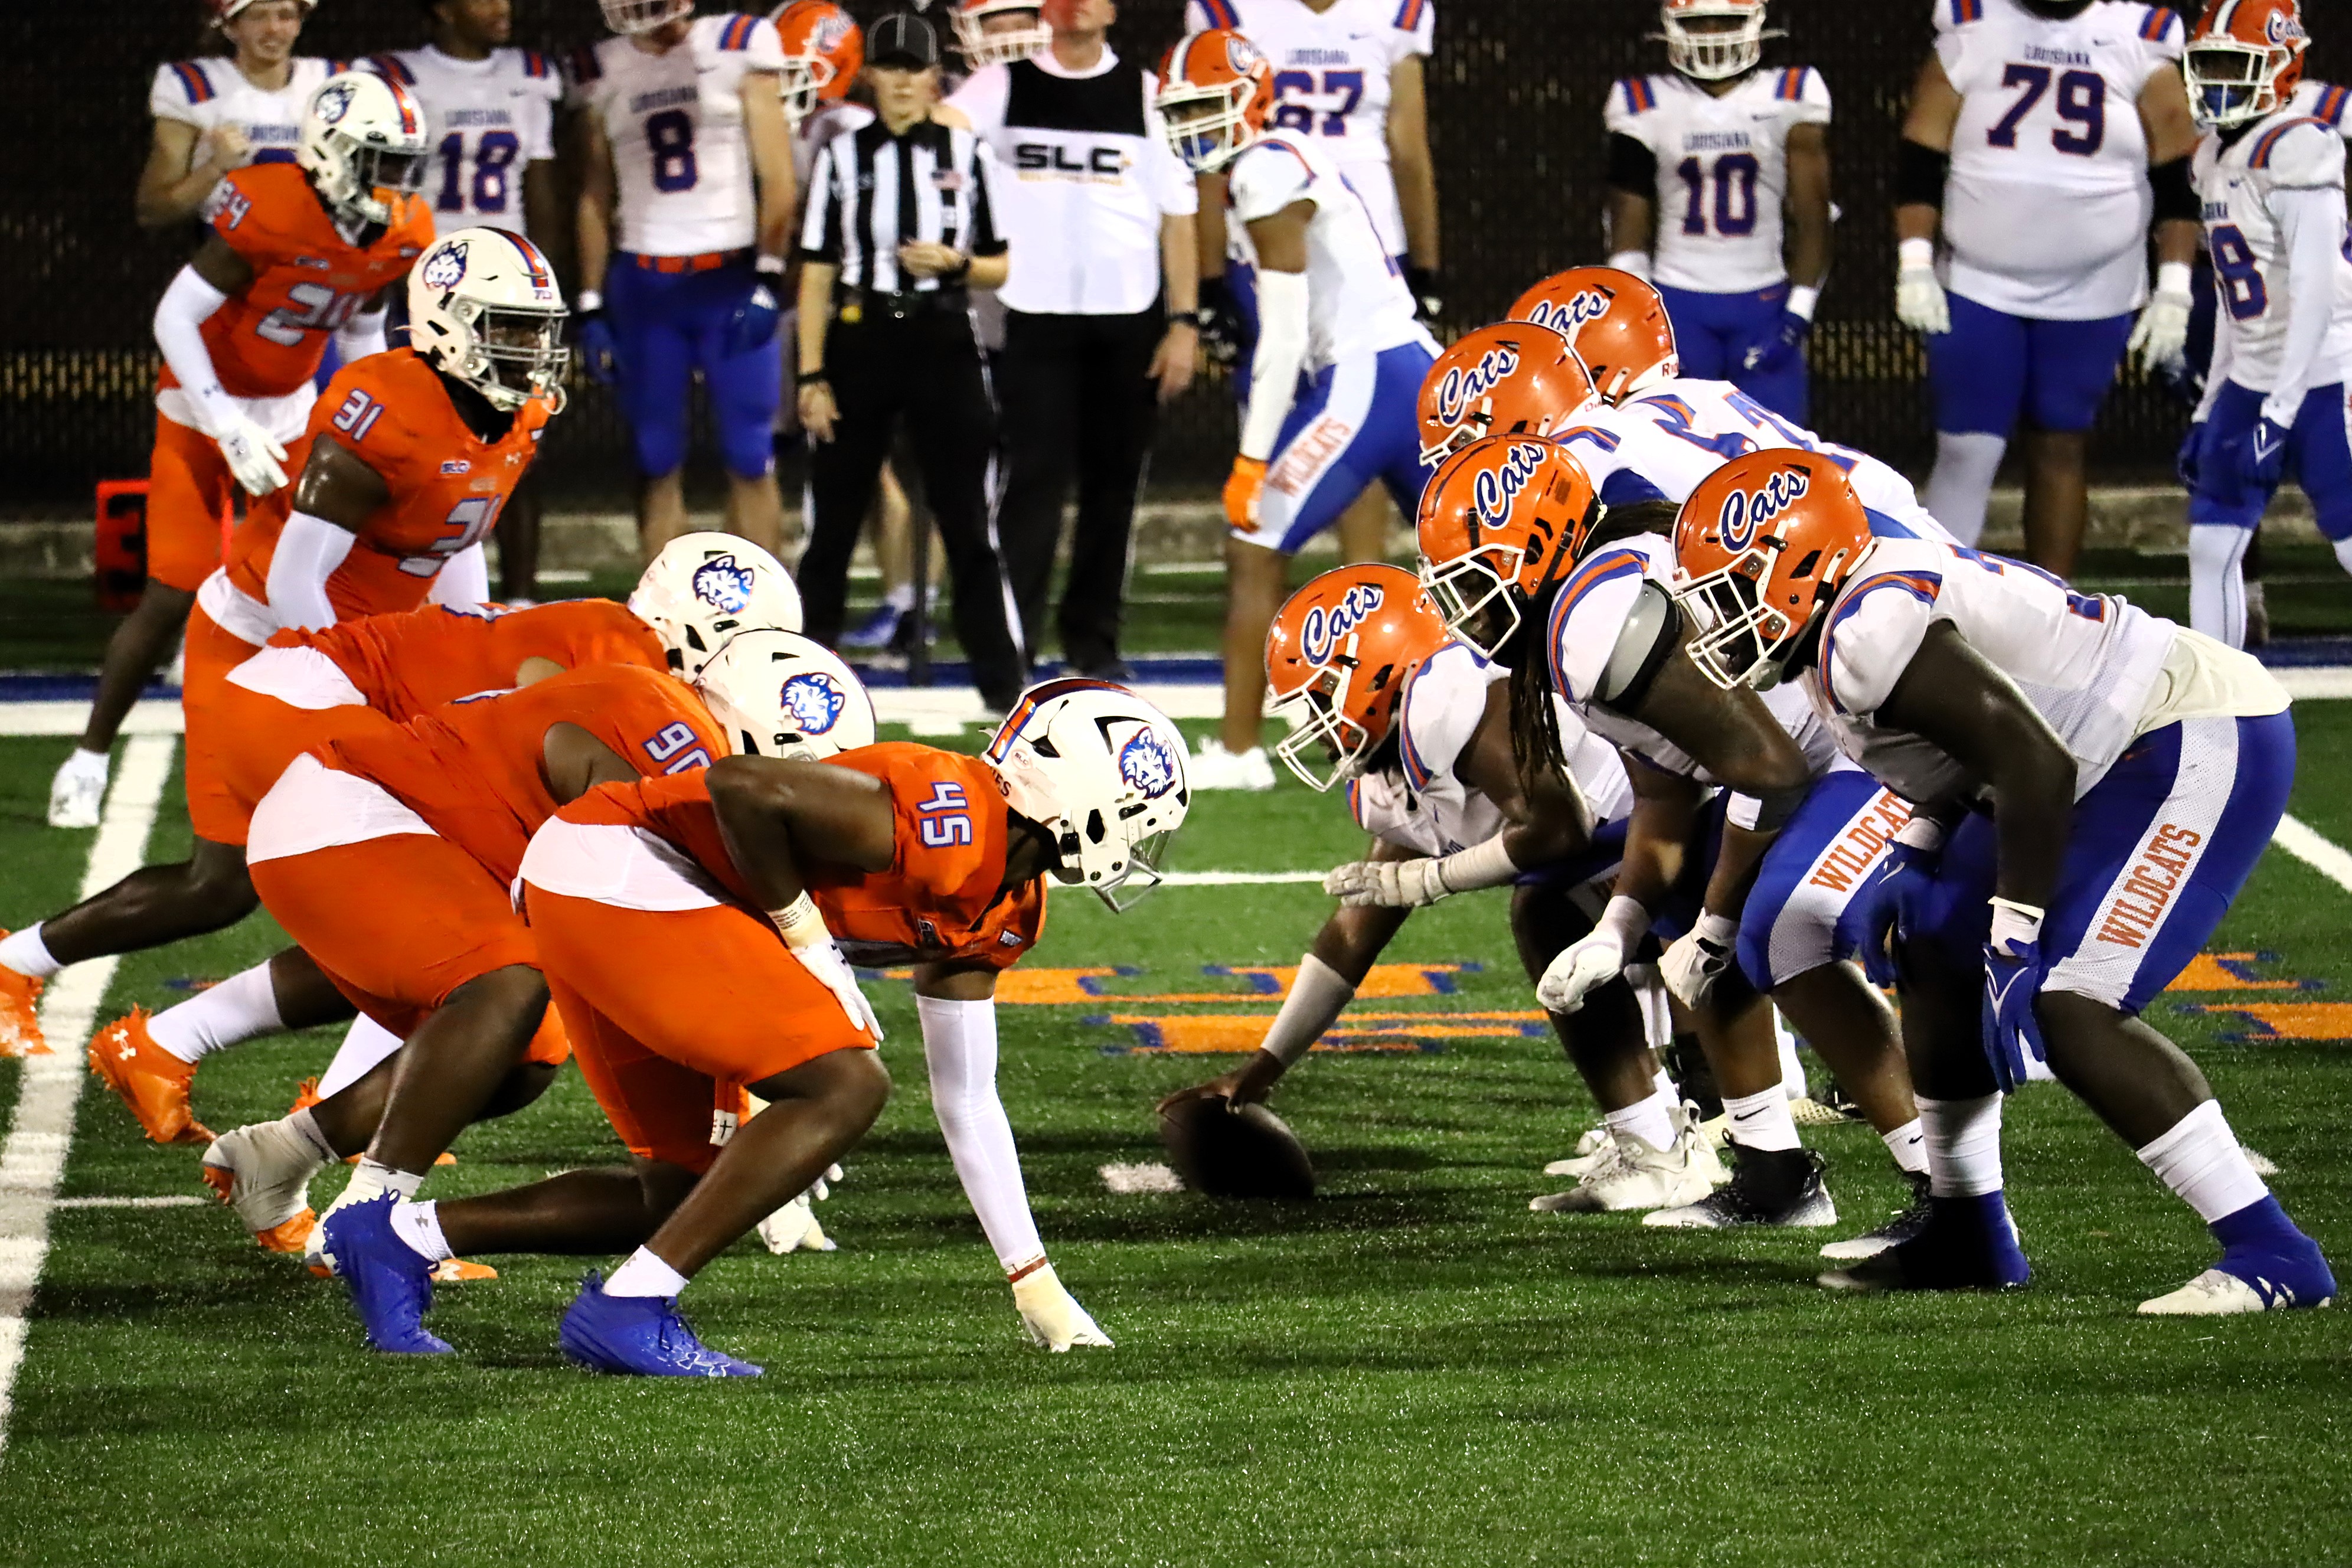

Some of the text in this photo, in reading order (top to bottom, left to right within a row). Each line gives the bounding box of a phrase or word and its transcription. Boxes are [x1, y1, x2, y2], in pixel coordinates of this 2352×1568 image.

[1273, 70, 1364, 138] 67
[1987, 63, 2105, 156] 79
[436, 131, 521, 213] 18
[644, 109, 698, 194] 8
[1015, 143, 1122, 175] SLC
[1677, 153, 1760, 237] 10
[332, 388, 386, 443] 31
[1439, 349, 1519, 426] Cats
[1474, 443, 1547, 528] Cats
[1719, 471, 1809, 554] Cats
[1301, 586, 1384, 668] Cats
[916, 782, 973, 849] 45
[1809, 790, 1913, 892] WILDCAT
[2096, 823, 2201, 949] WILDCATS
